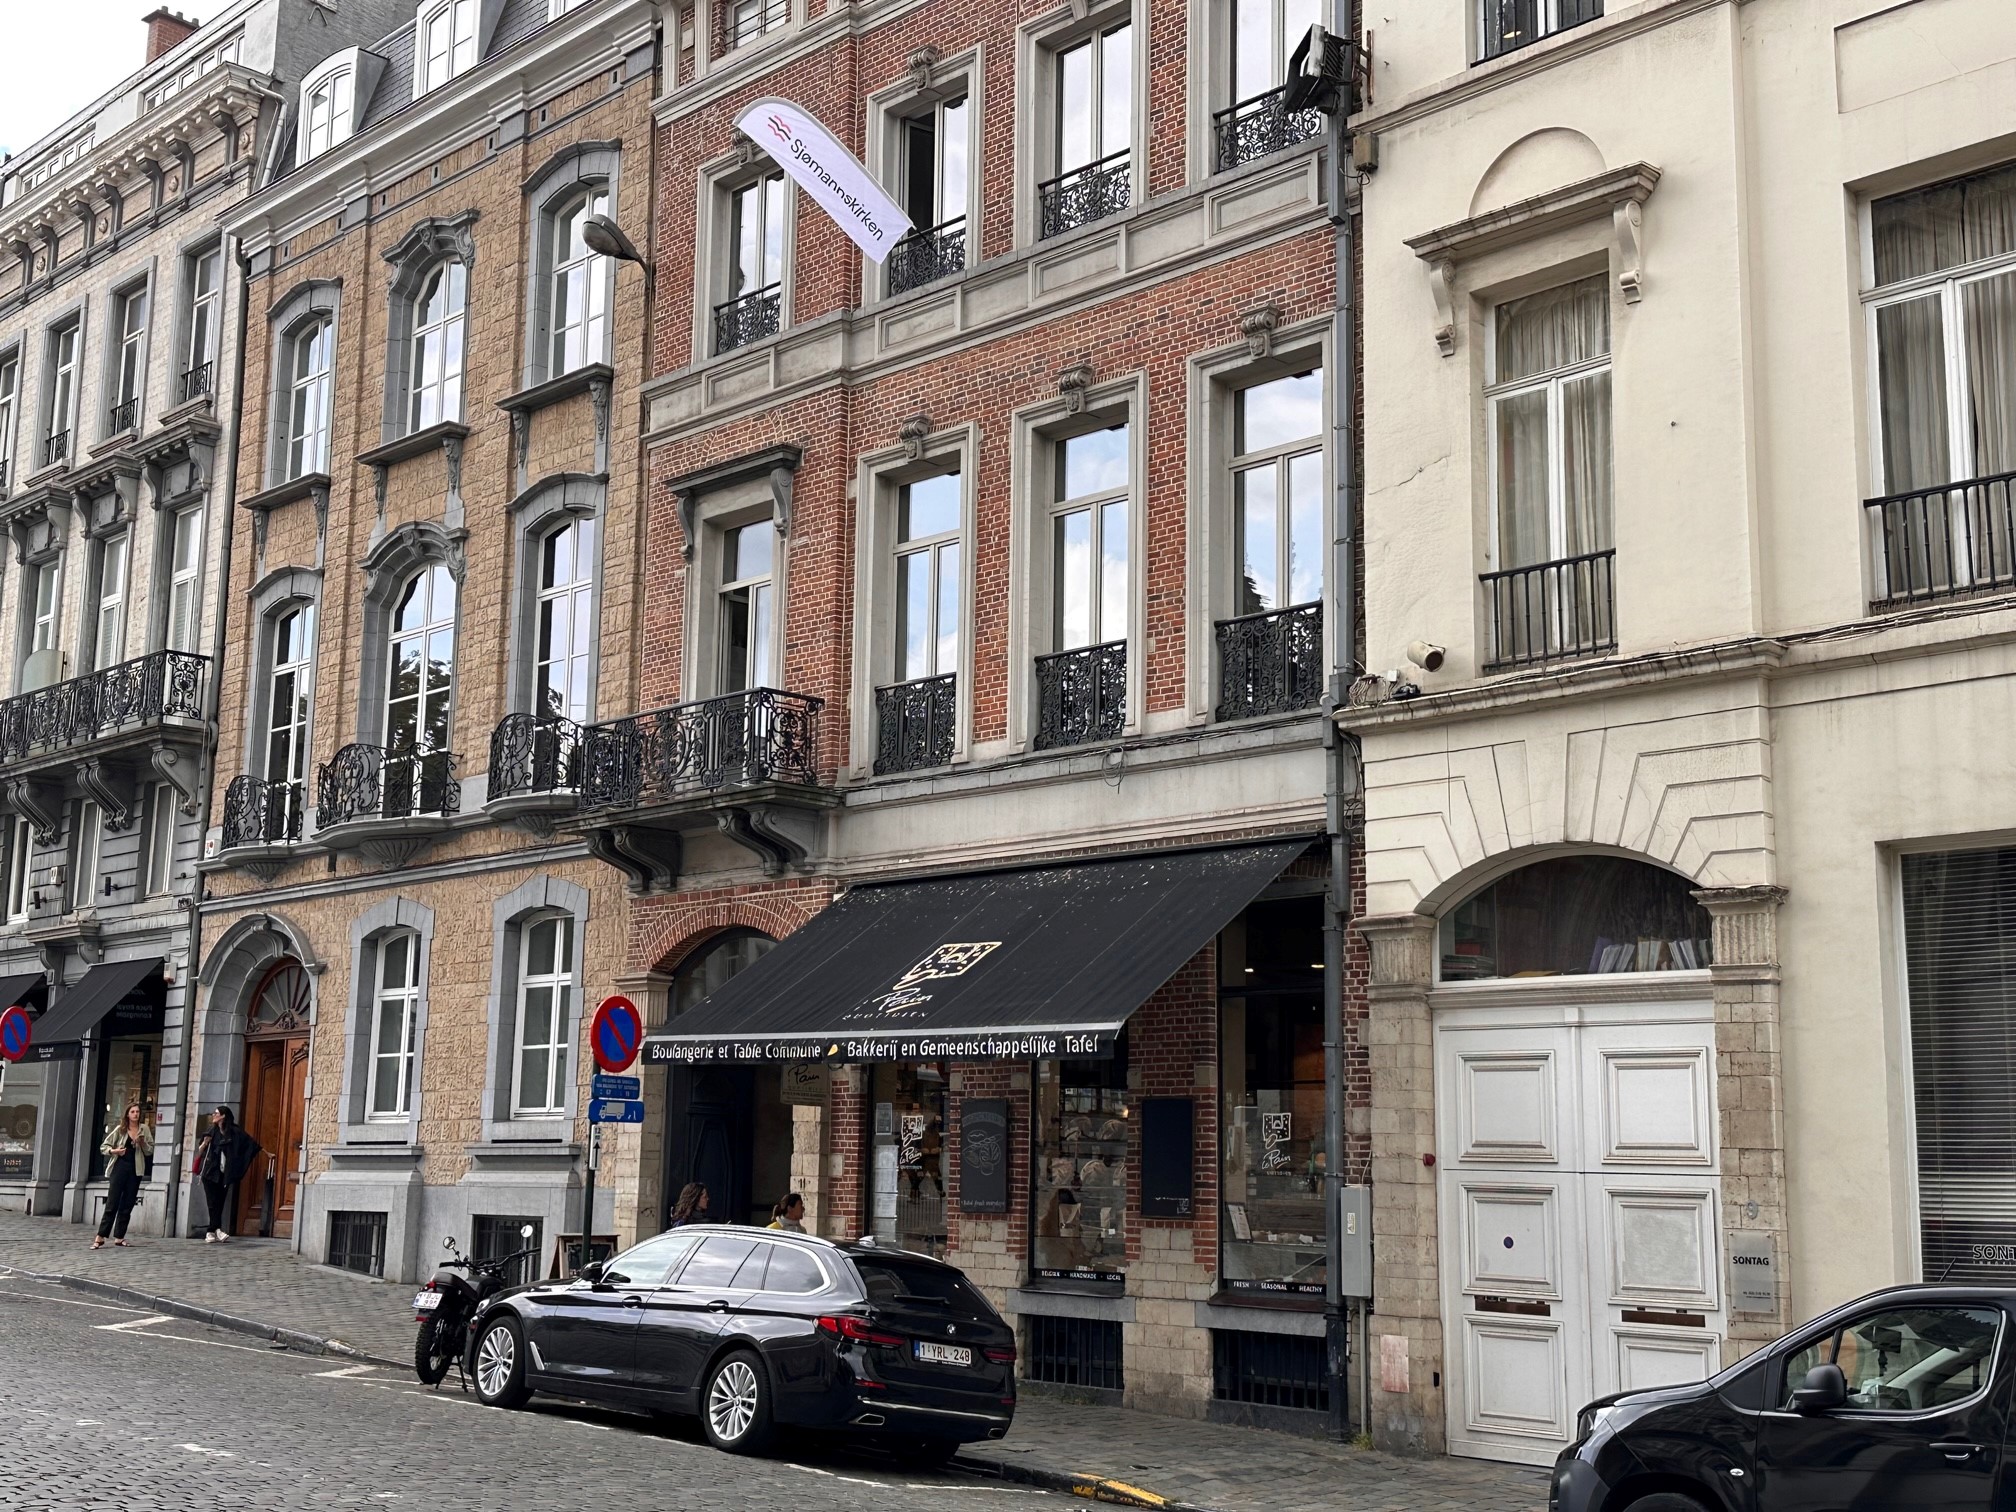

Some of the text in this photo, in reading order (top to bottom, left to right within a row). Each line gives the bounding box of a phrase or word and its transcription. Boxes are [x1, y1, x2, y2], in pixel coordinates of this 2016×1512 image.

[790, 138, 884, 241] Sjømannskirken
[652, 1034, 1099, 1062] Boulangerie et Table Commune Bakkerij en Gemeenschappelijke Tafel
[1263, 1149, 1292, 1168] Pain
[1747, 1199, 1759, 1220] 9
[1732, 1255, 1770, 1266] SONTAG
